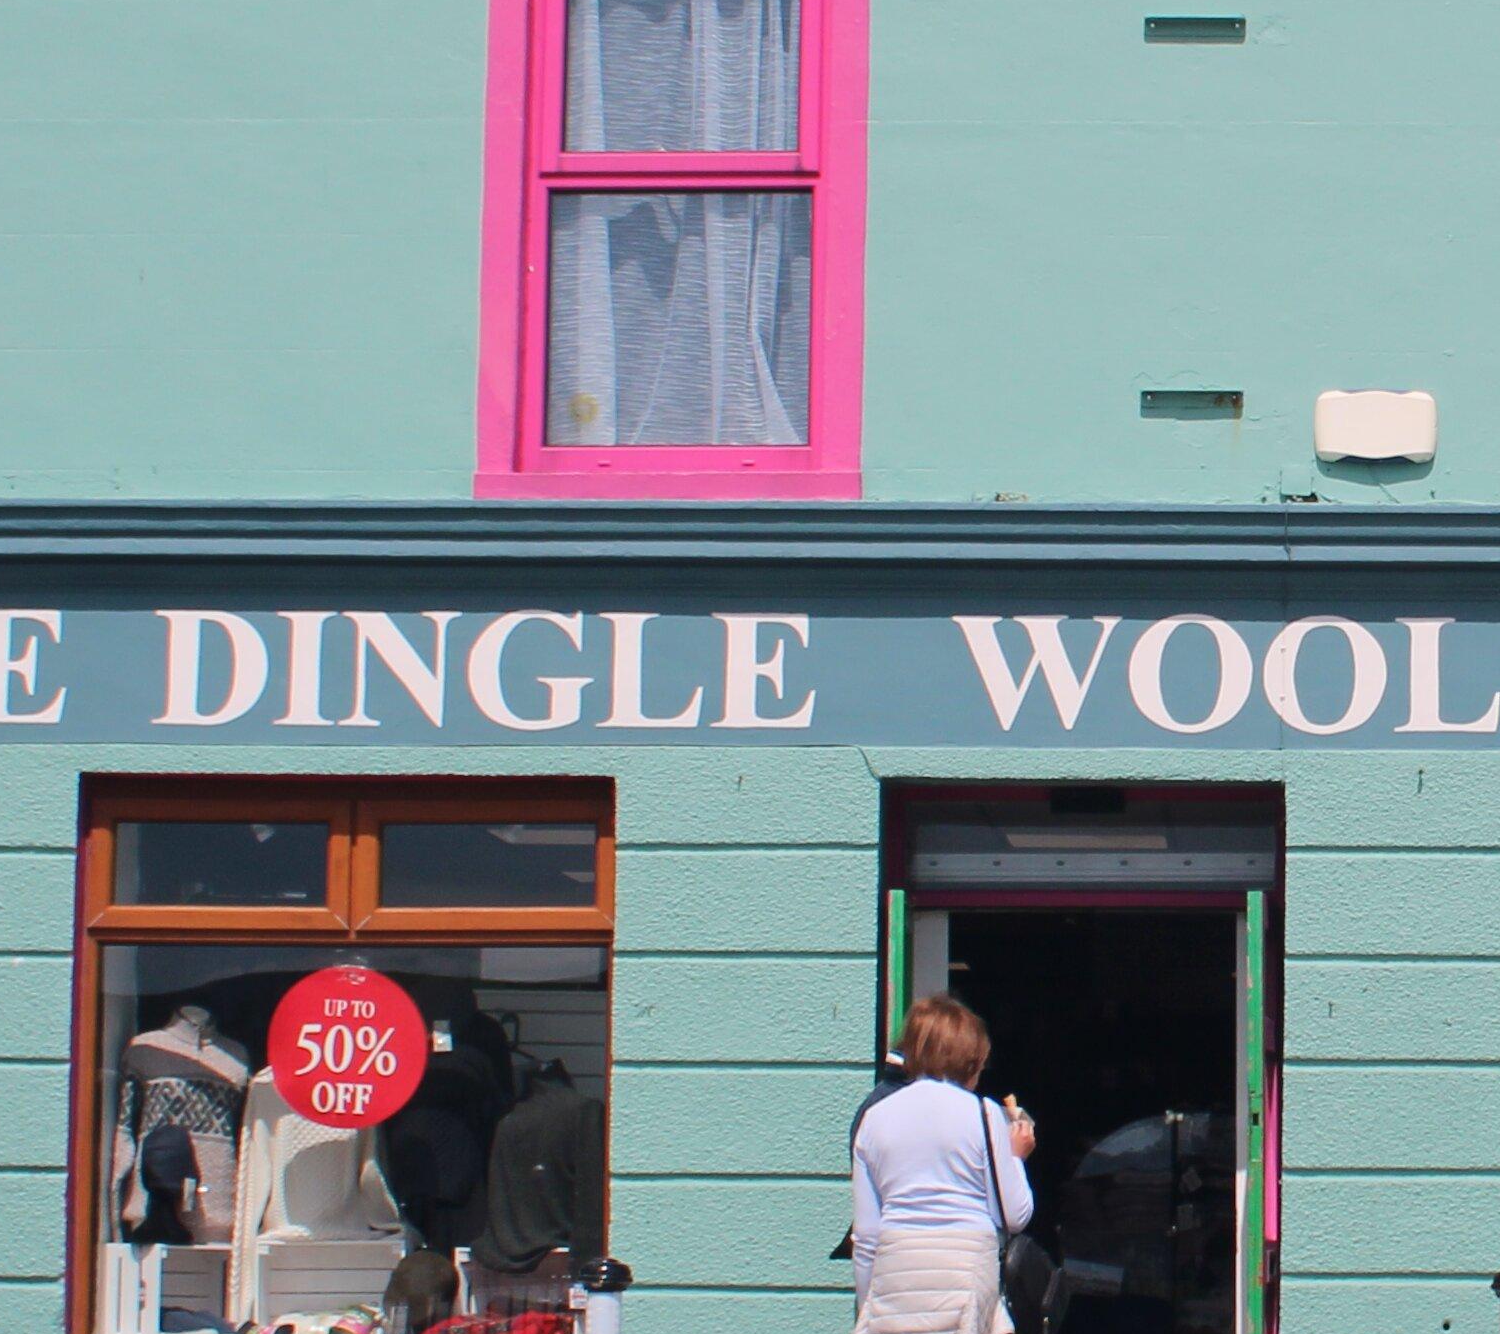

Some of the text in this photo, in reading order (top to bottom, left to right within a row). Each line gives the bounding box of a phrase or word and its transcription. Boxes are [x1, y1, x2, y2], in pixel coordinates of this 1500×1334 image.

[151, 609, 817, 731] DINGLE
[323, 998, 376, 1019] UP TO
[294, 1023, 398, 1077] 50%
[311, 1080, 374, 1115] OFF
